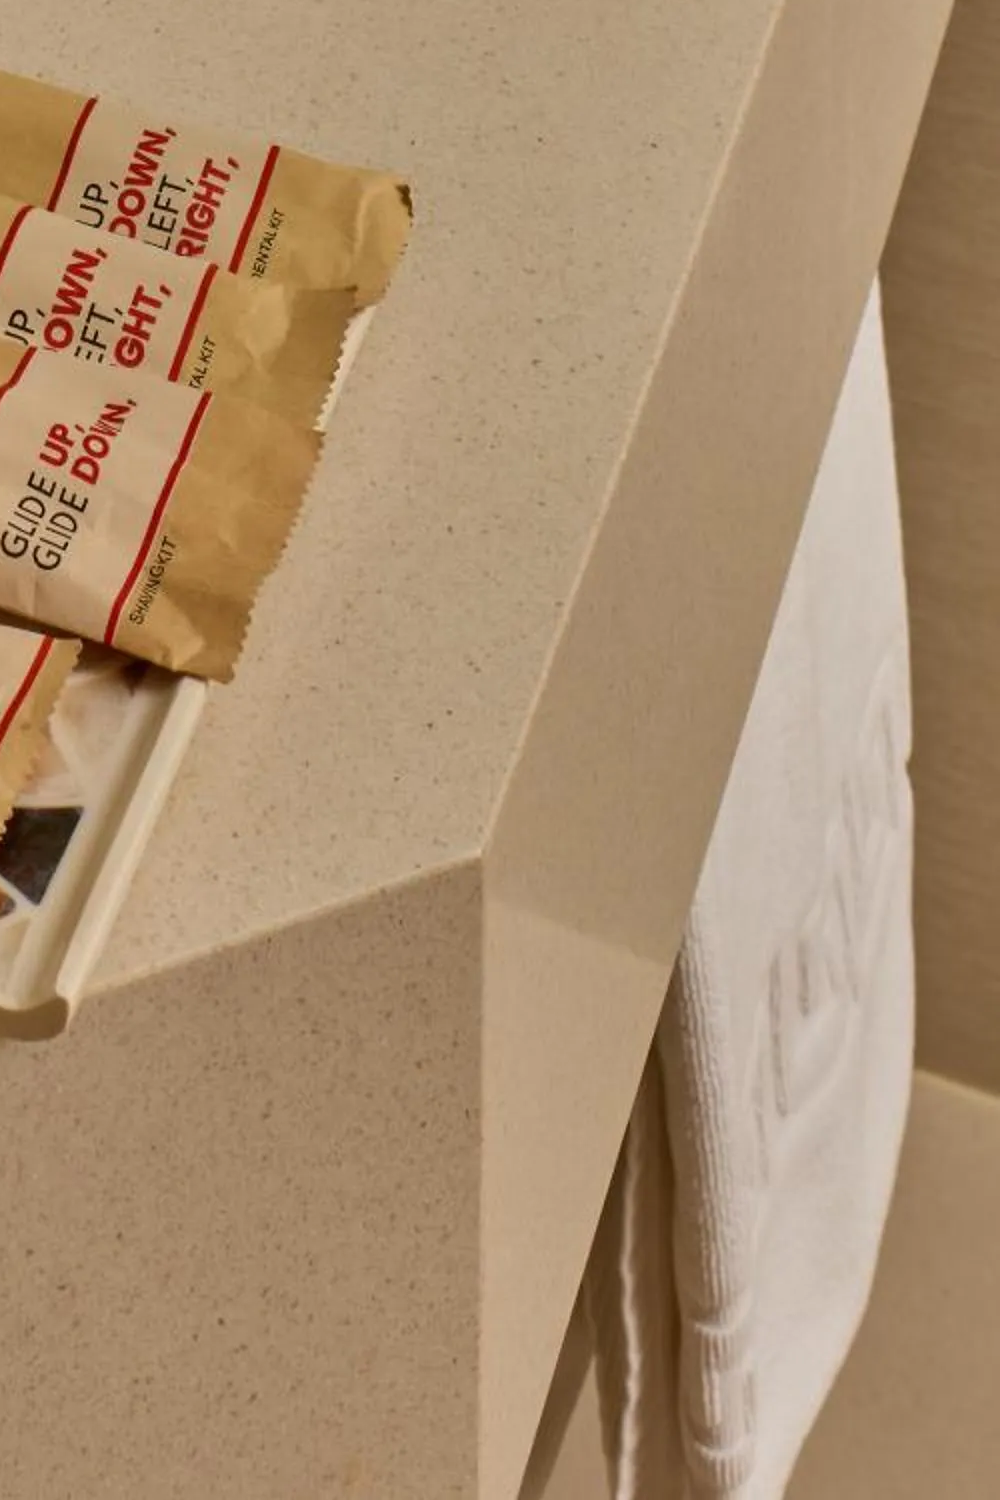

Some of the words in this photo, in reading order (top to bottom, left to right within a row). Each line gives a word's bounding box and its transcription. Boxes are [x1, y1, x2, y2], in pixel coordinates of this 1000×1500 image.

[75, 180, 119, 229] UP,
[108, 128, 177, 239] DOWN,
[143, 174, 194, 251] LEFT,
[175, 157, 240, 257] RIGHT,
[43, 247, 107, 353] OWN,
[74, 302, 123, 363] EFT,
[113, 284, 172, 369] GHT,
[188, 366, 207, 389] TAL
[200, 335, 216, 366] KIT
[0, 471, 57, 559] GLIDE
[39, 423, 85, 468] UP,
[33, 487, 89, 571] GLIDE
